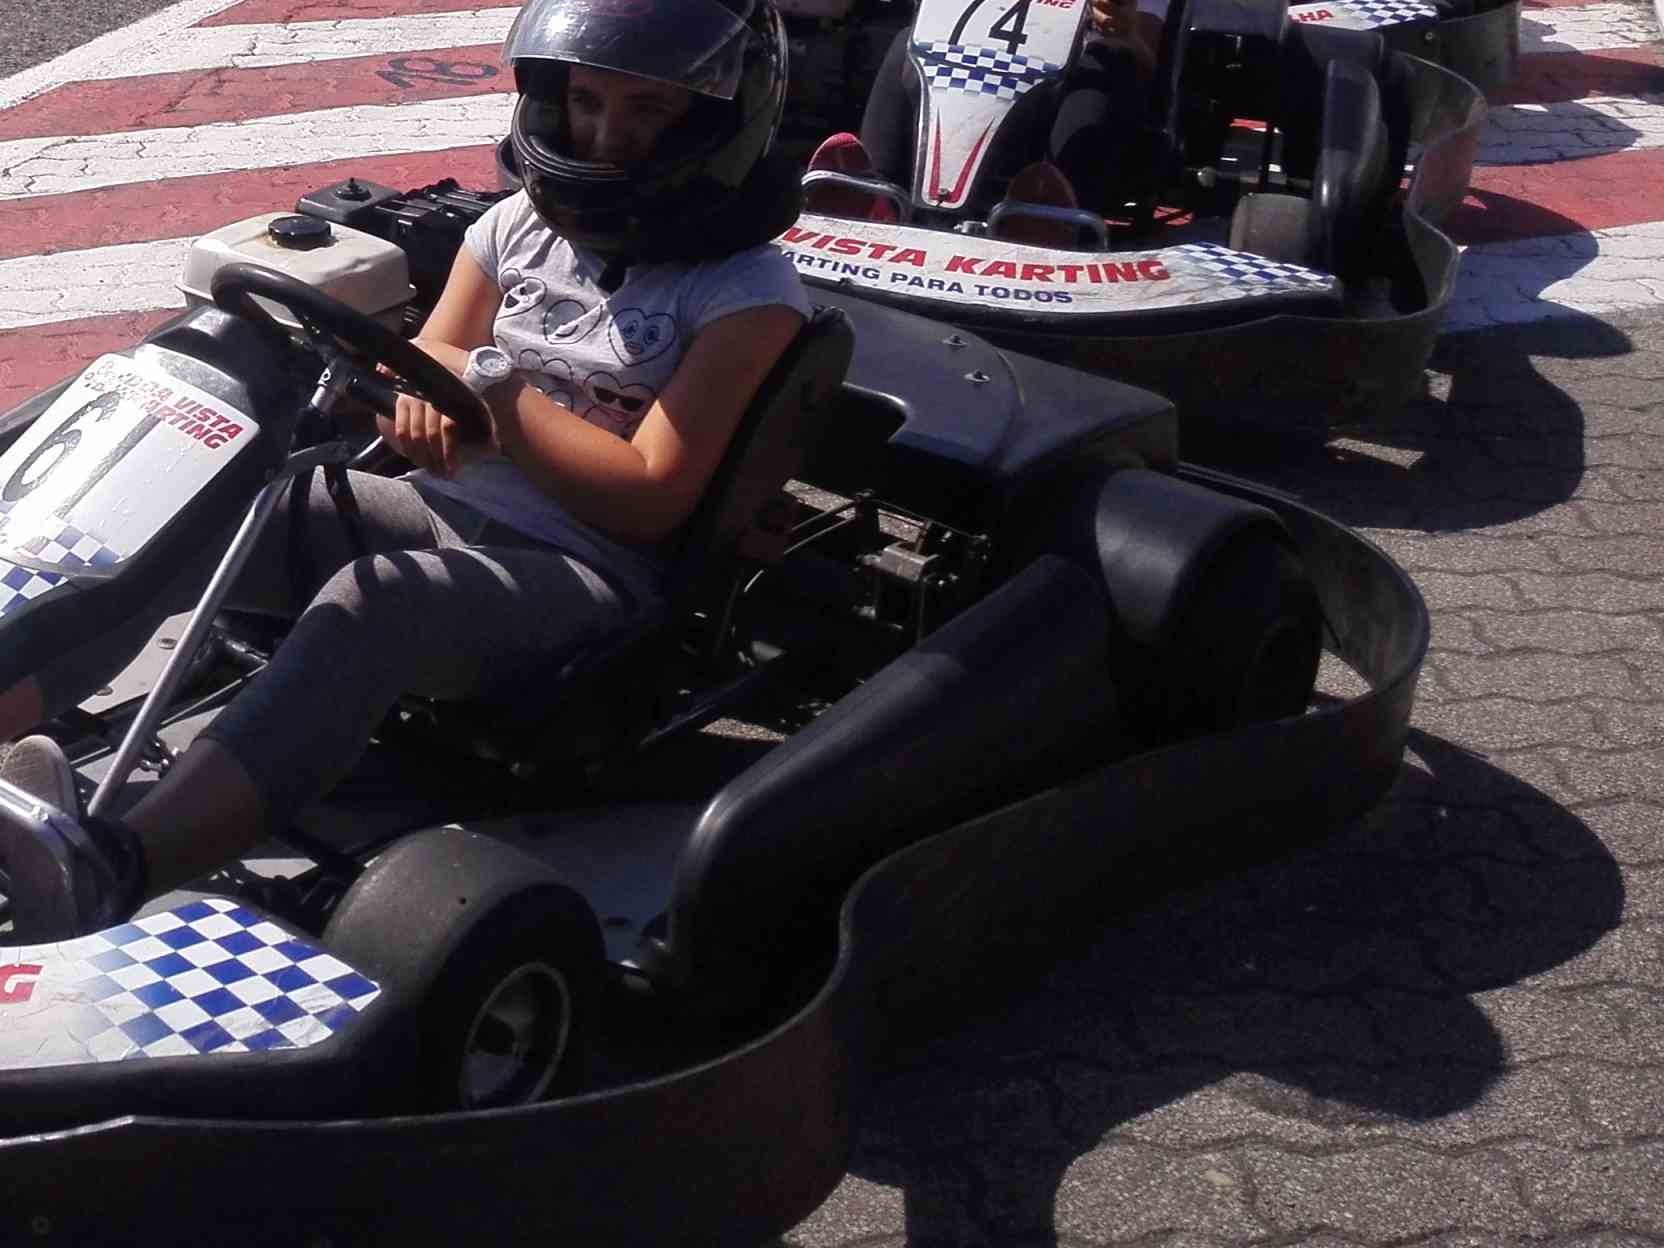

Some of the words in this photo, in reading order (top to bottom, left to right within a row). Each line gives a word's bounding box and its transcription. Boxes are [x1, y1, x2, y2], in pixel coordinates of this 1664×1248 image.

[782, 227, 928, 268] VISTA
[943, 254, 1171, 286] KARTING
[782, 251, 881, 281] ARTING
[889, 271, 965, 295] PARA
[975, 283, 1073, 304] TODOS
[174, 395, 245, 439] VISTA
[2, 391, 162, 522] 61
